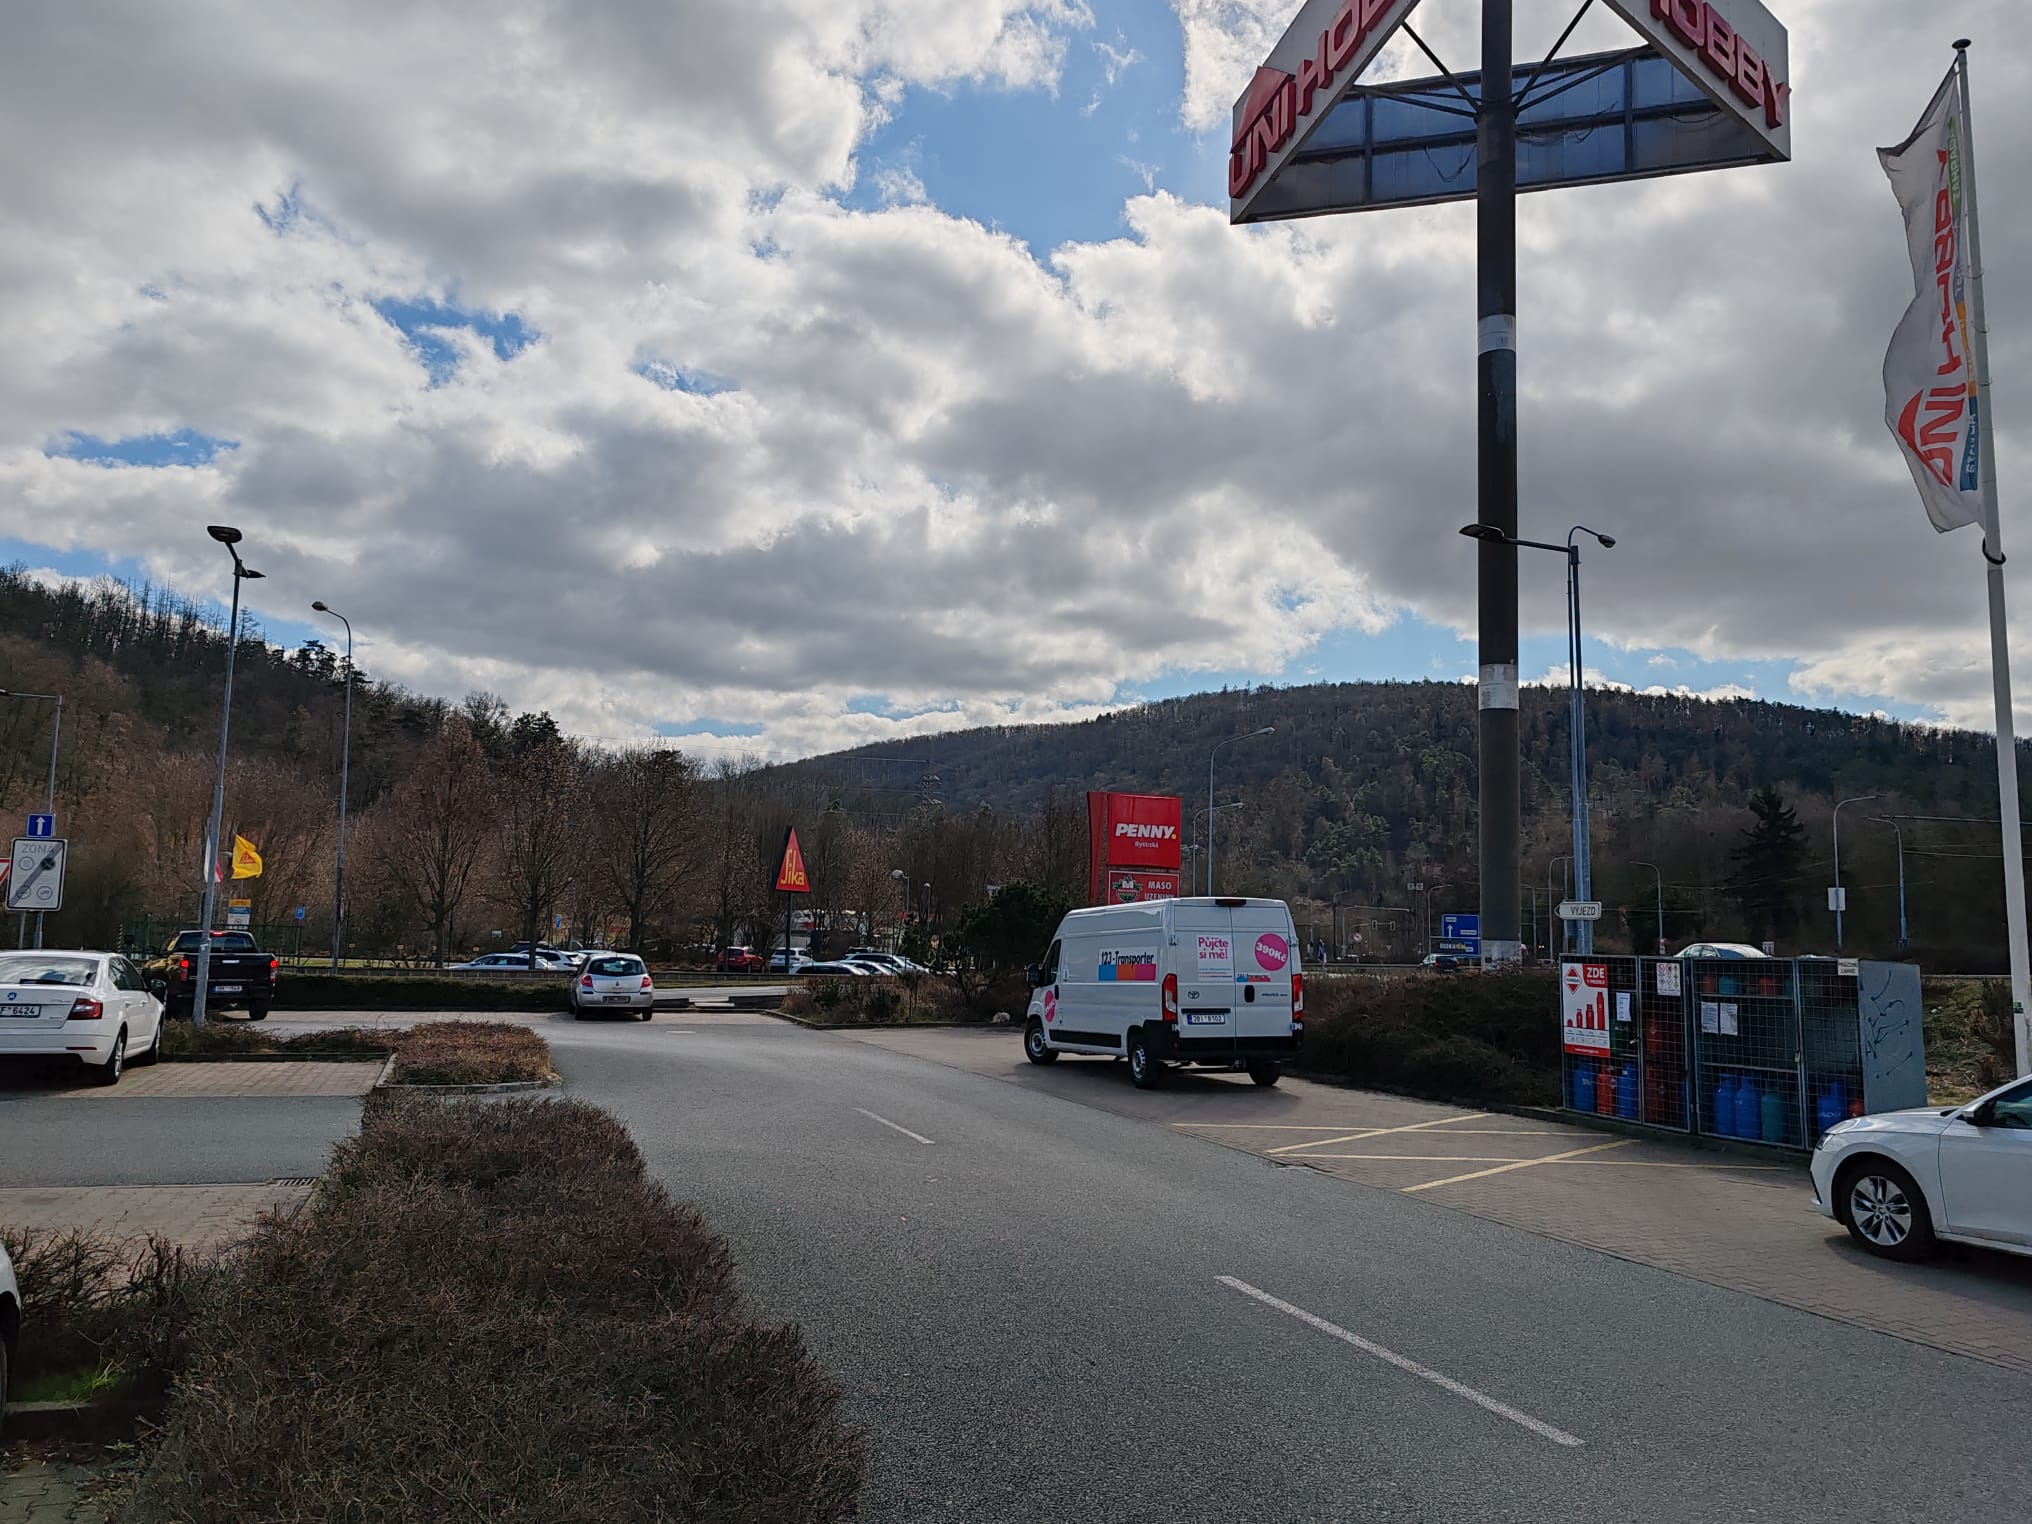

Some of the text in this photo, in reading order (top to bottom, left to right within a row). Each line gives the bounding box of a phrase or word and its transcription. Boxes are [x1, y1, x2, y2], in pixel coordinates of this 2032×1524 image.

[780, 848, 805, 885] Sika
[1148, 881, 1172, 890] MASO
[1198, 936, 1229, 950] Půjčte
[1199, 948, 1228, 960] si mě!
[1255, 942, 1288, 962] 390Kč
[1586, 967, 1605, 979] ZDE
[12, 1006, 35, 1015] 6424
